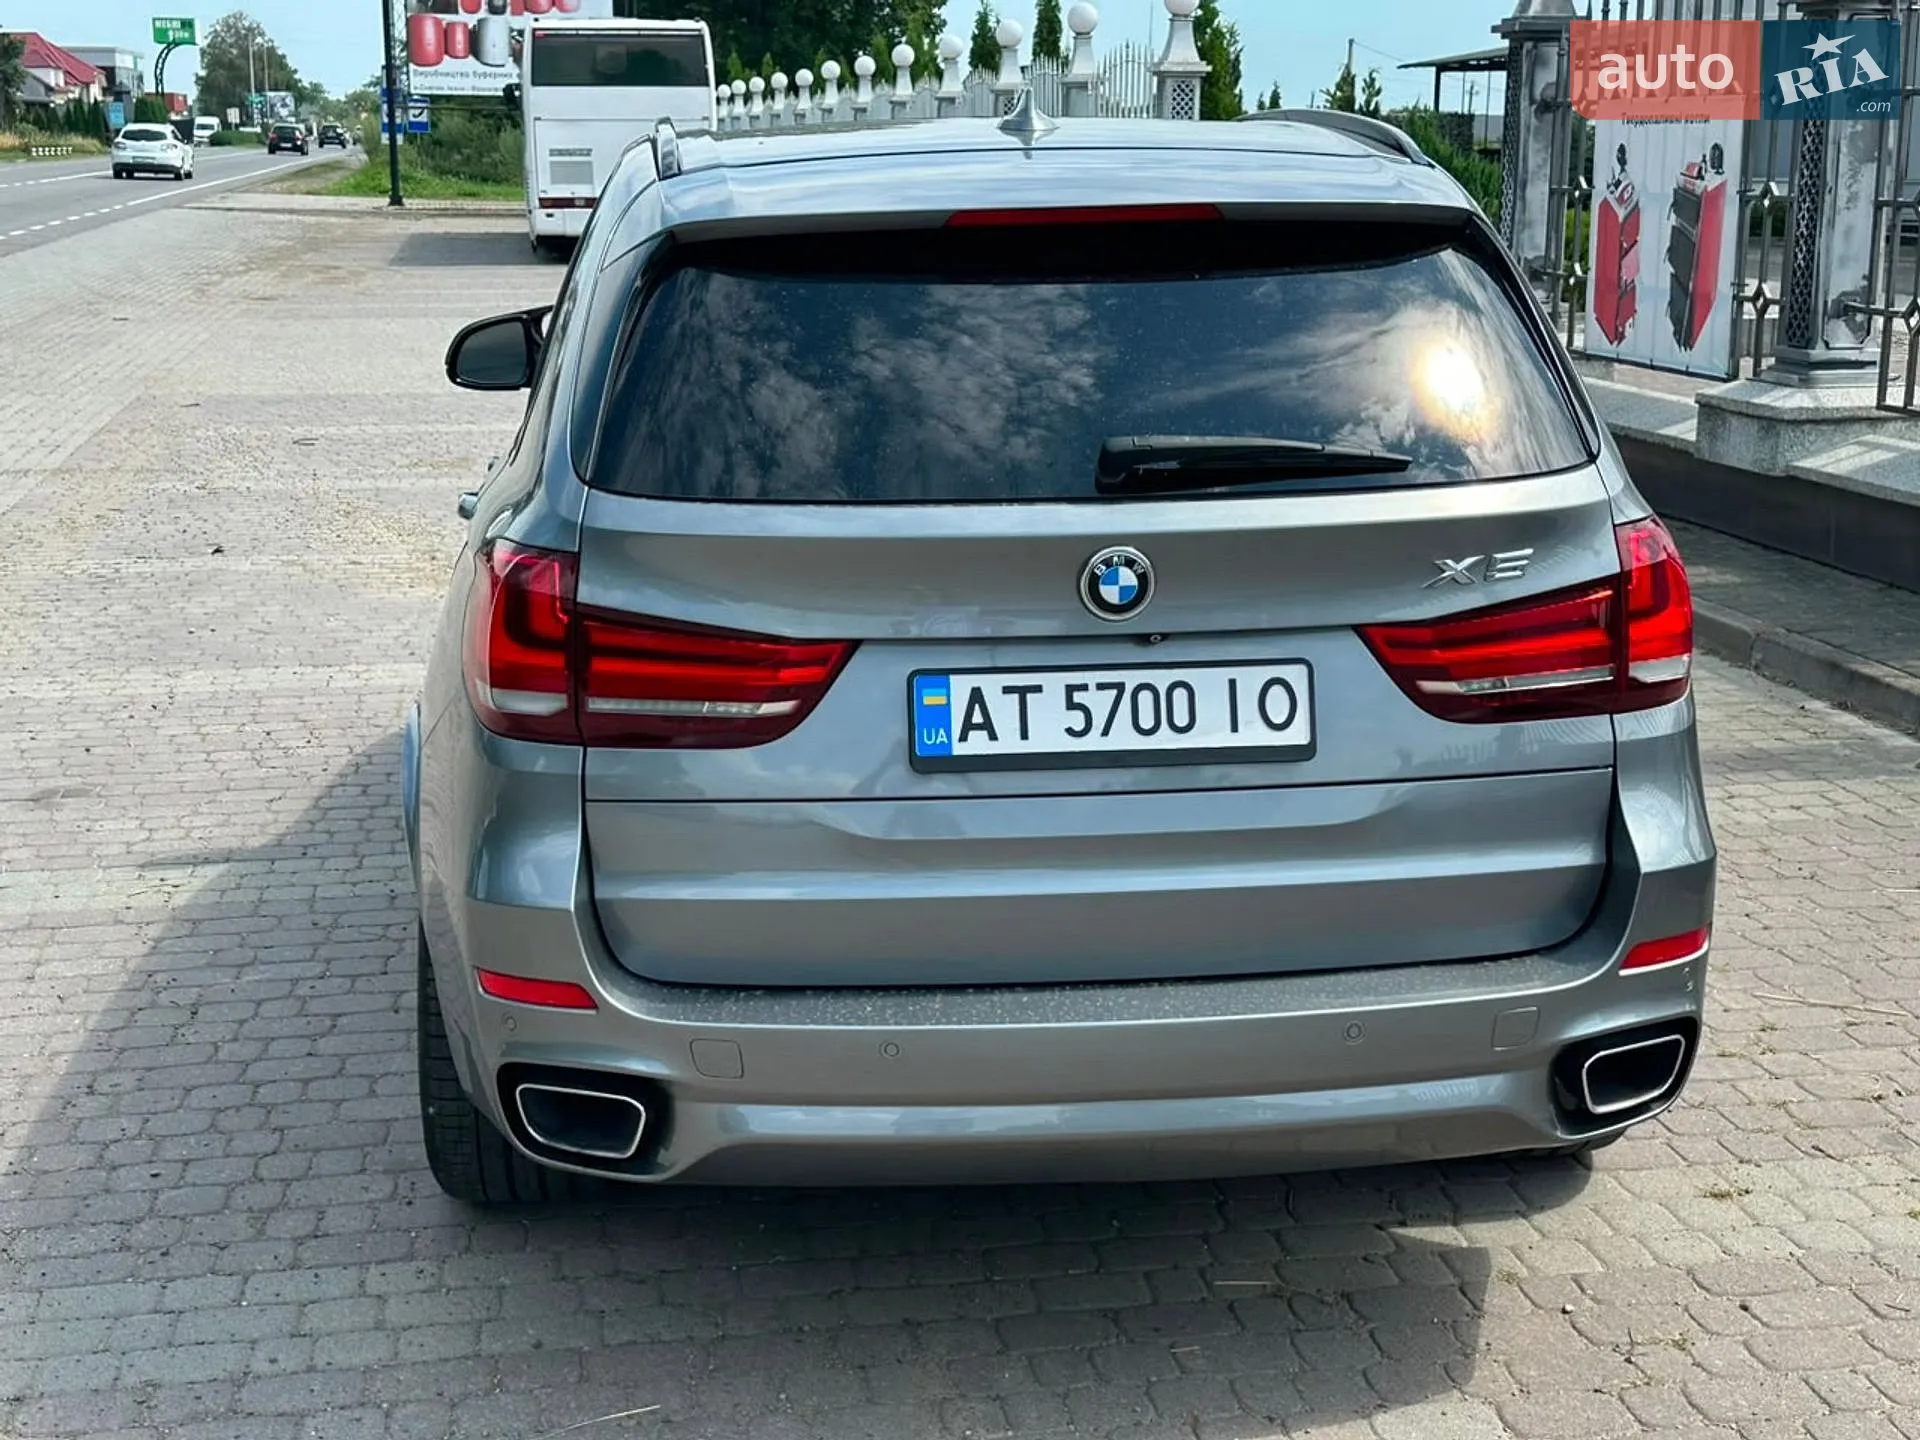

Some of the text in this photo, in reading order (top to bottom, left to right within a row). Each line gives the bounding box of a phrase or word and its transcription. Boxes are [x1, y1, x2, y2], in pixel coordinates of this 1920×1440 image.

[1093, 555, 1145, 576] BMW
[958, 684, 1043, 743] AT
[1064, 679, 1197, 739] 5700
[923, 728, 949, 745] UA
